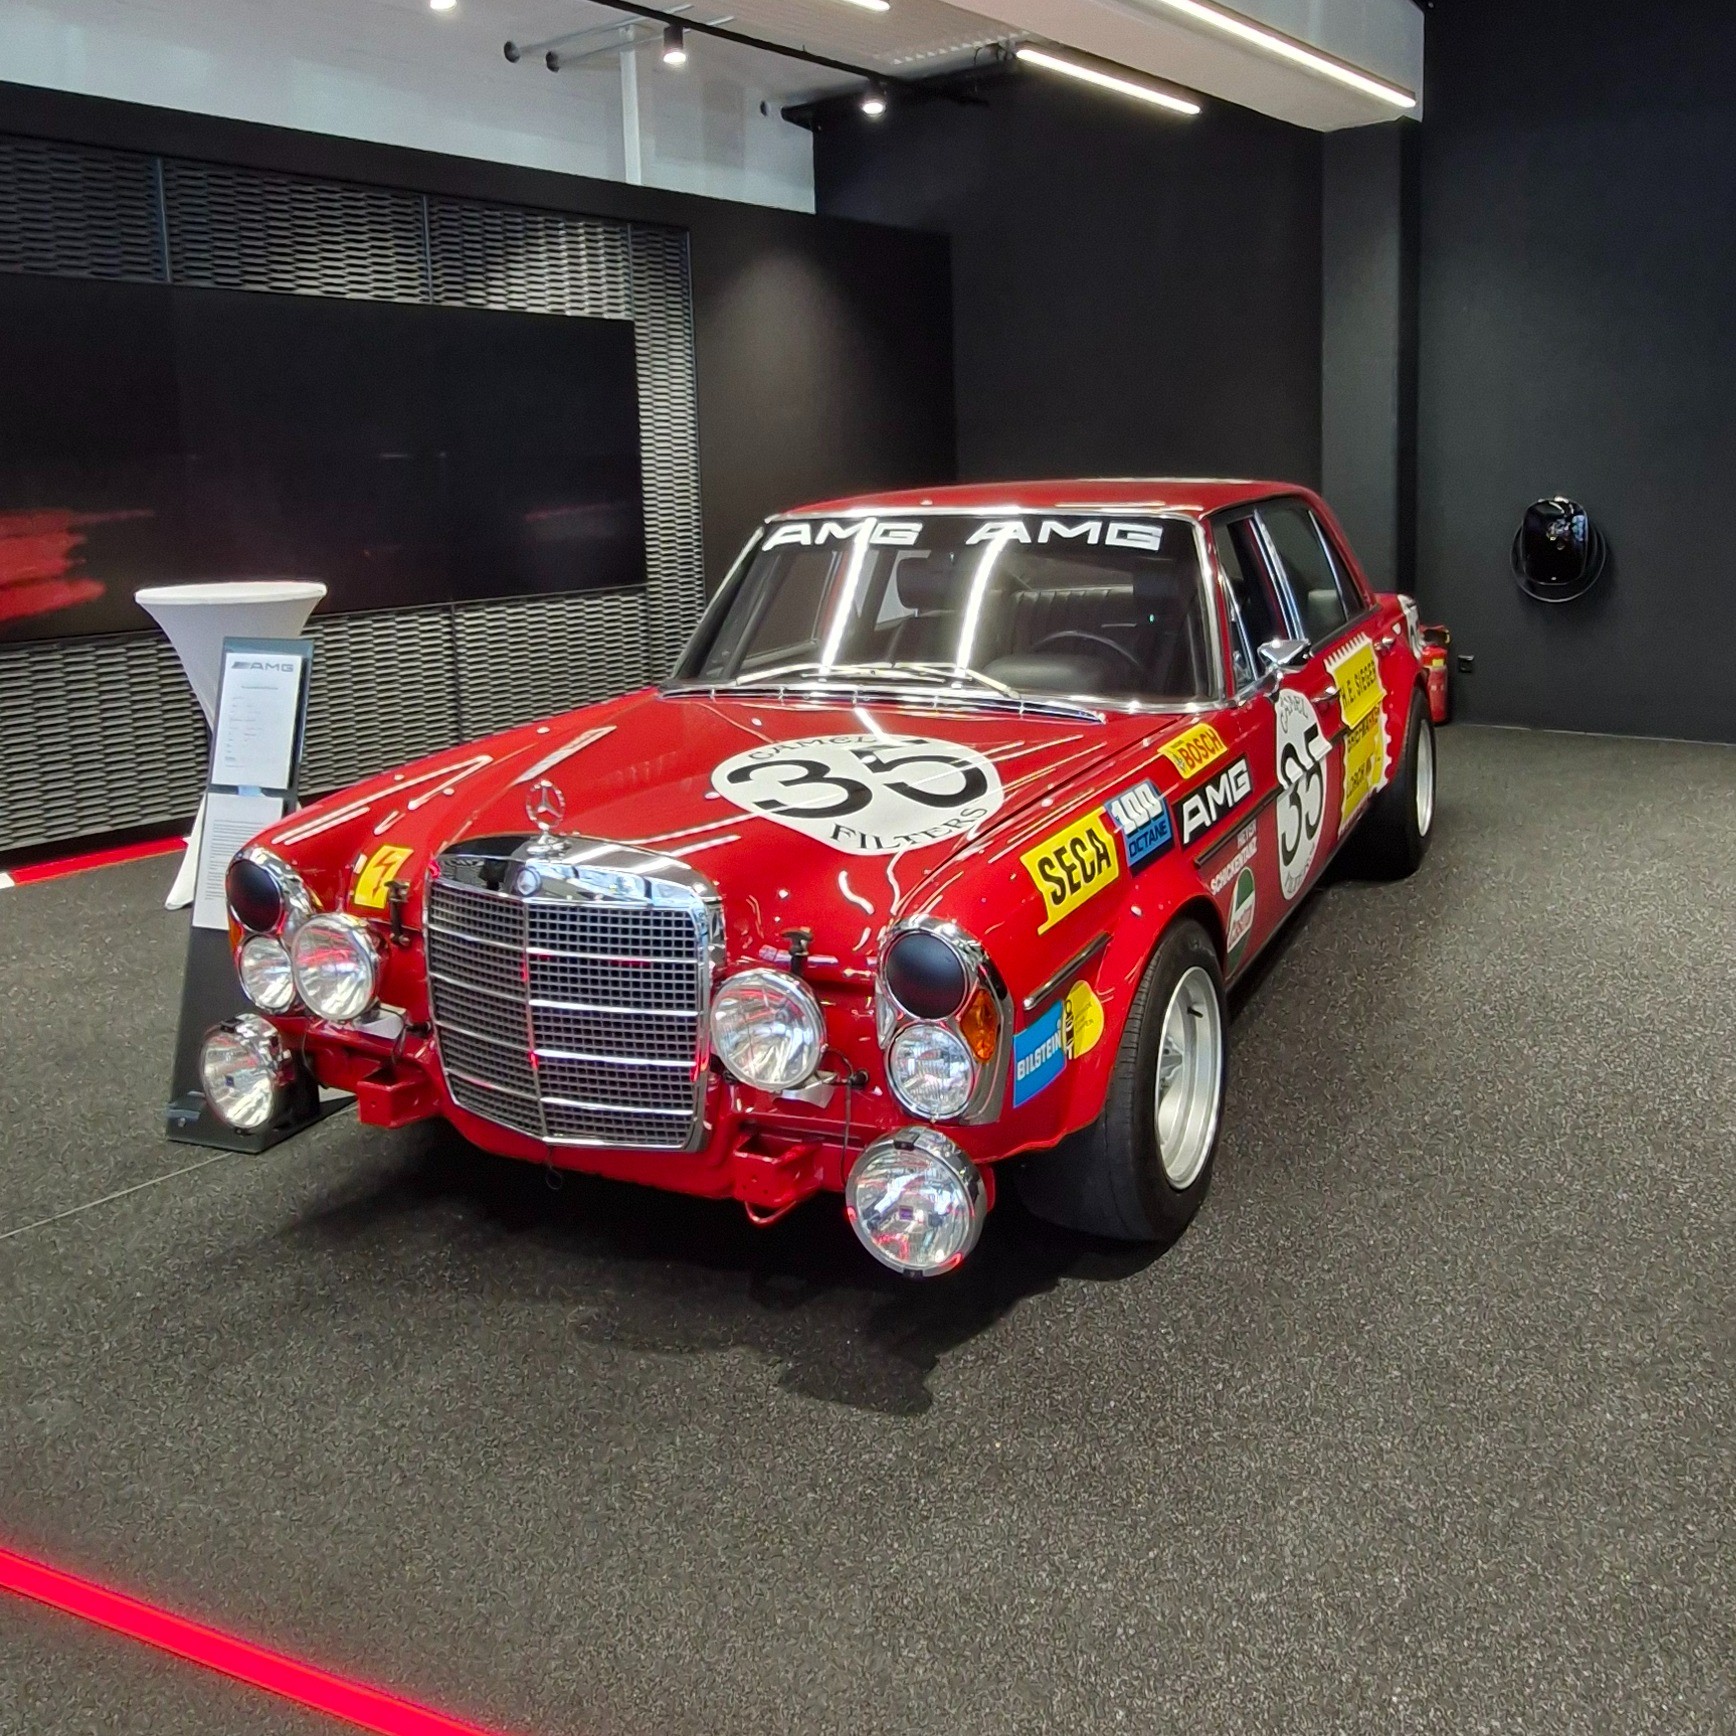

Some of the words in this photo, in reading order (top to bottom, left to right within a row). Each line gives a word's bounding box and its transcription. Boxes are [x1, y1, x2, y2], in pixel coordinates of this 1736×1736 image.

[762, 521, 923, 551] AMG
[965, 520, 1163, 551] AMG
[249, 661, 294, 673] AMG
[748, 734, 879, 761] CAMEL
[1177, 728, 1224, 770] BOSCH
[727, 737, 988, 819] 35
[1182, 758, 1252, 844] AMG
[1280, 722, 1325, 868] 35
[829, 805, 988, 850] FILTERS
[1110, 782, 1164, 835] 100
[1128, 820, 1169, 859] OCTANE
[1037, 827, 1112, 906] SECA
[1017, 1030, 1063, 1081] BILSTEIN
